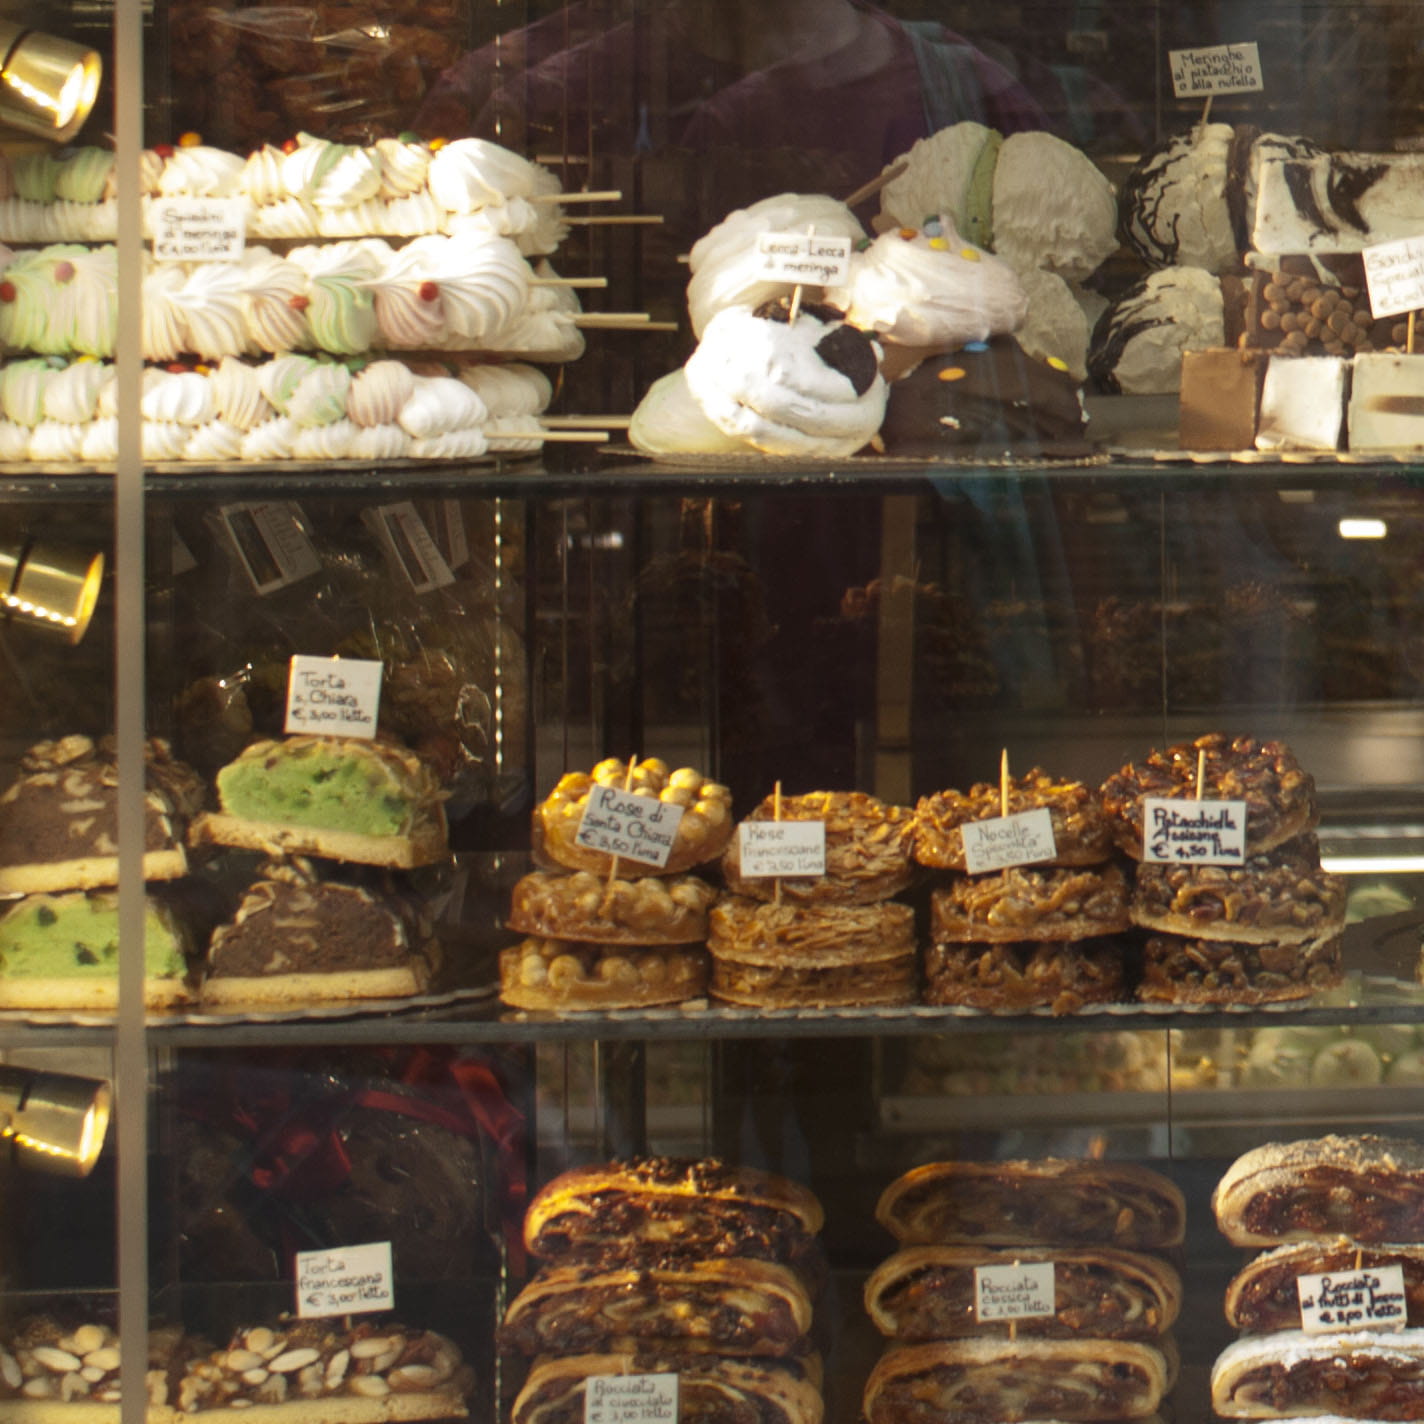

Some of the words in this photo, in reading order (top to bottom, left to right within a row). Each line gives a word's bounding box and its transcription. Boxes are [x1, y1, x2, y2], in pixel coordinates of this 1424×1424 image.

[300, 670, 346, 689] Torta
[600, 788, 644, 819] Rose
[649, 802, 668, 823] di
[1150, 841, 1169, 859] €
[300, 1256, 346, 1274] Torta
